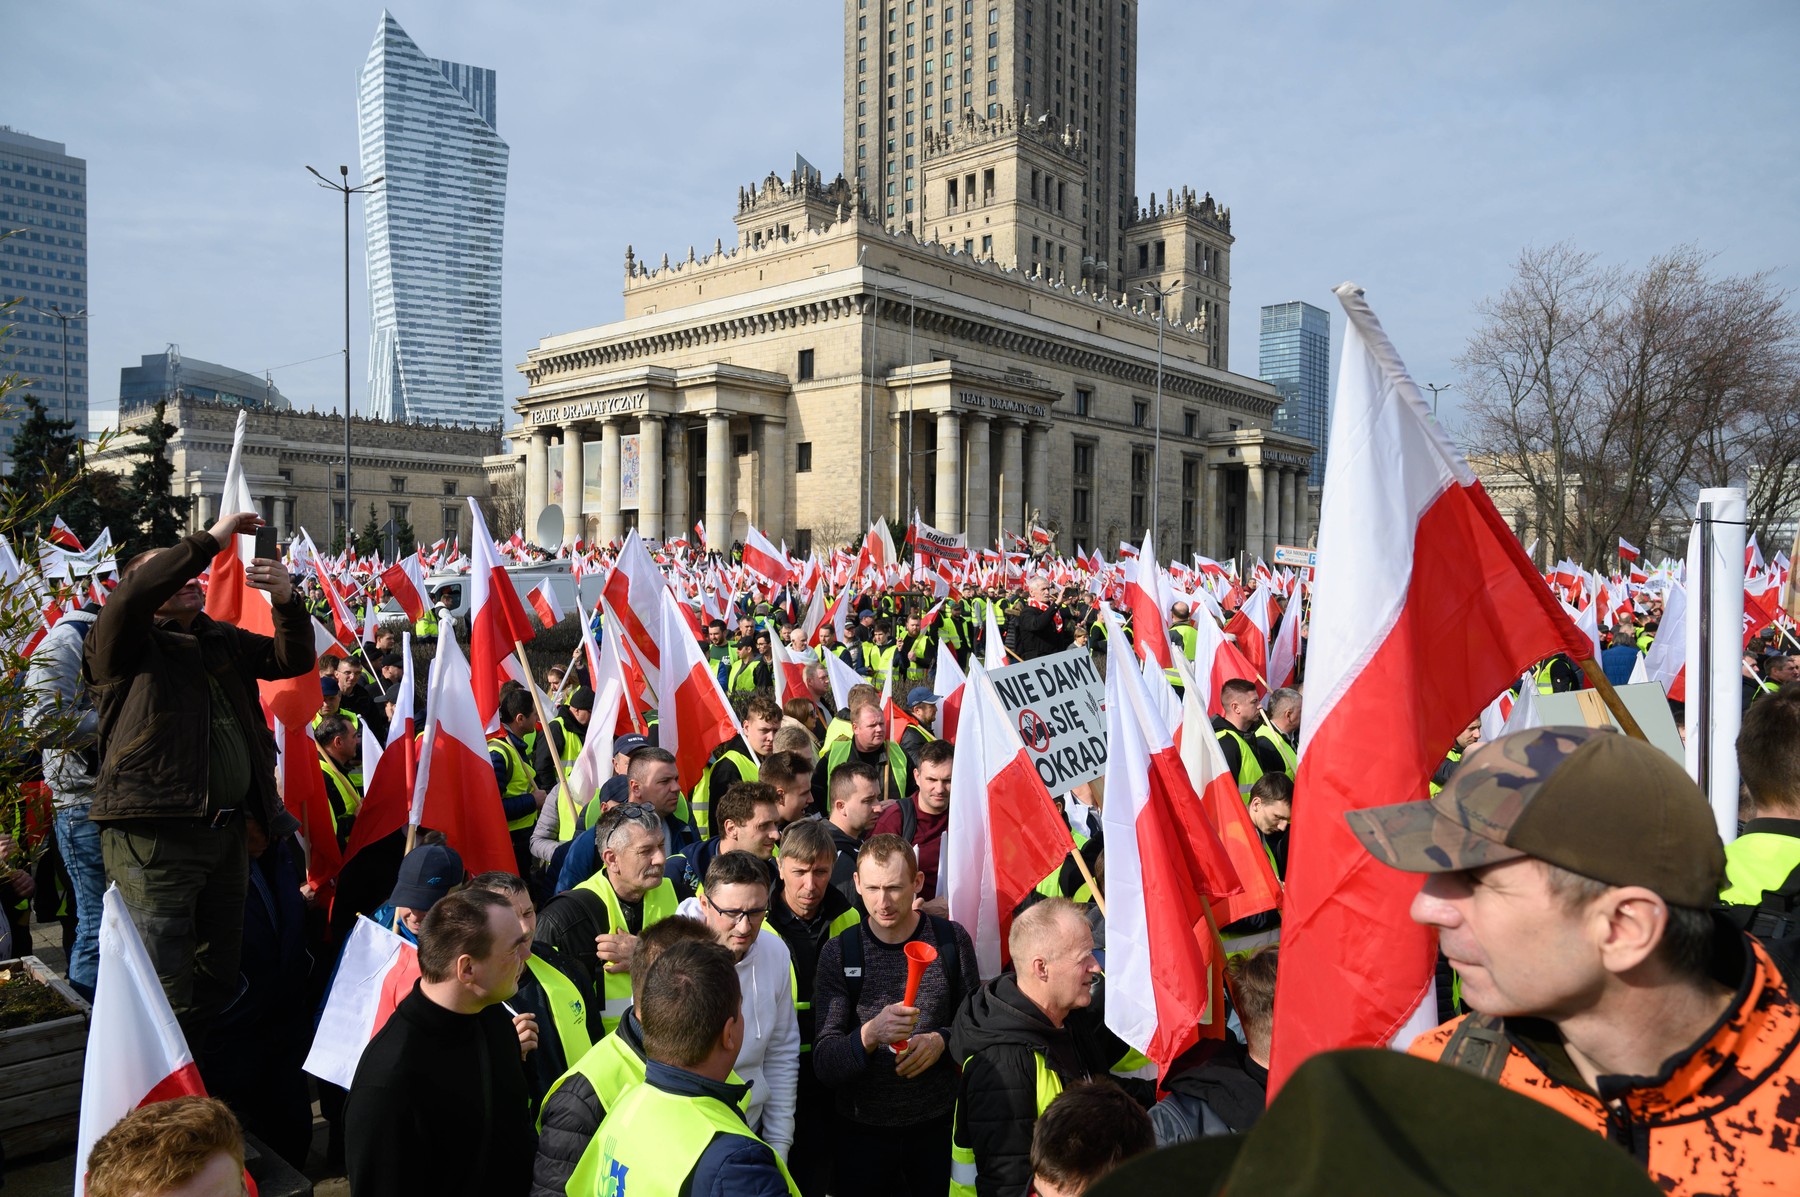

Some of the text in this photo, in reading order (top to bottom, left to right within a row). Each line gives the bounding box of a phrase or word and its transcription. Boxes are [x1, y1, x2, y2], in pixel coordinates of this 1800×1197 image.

[530, 393, 644, 424] TEATR DRAMATYCZNY
[960, 391, 1046, 417] TEATR DRAMATYCZNY
[926, 531, 959, 547] ROLNICY
[994, 655, 1097, 711] NIE DAMY
[1050, 700, 1088, 734] SIĘ
[1035, 731, 1108, 788] OKRAD
